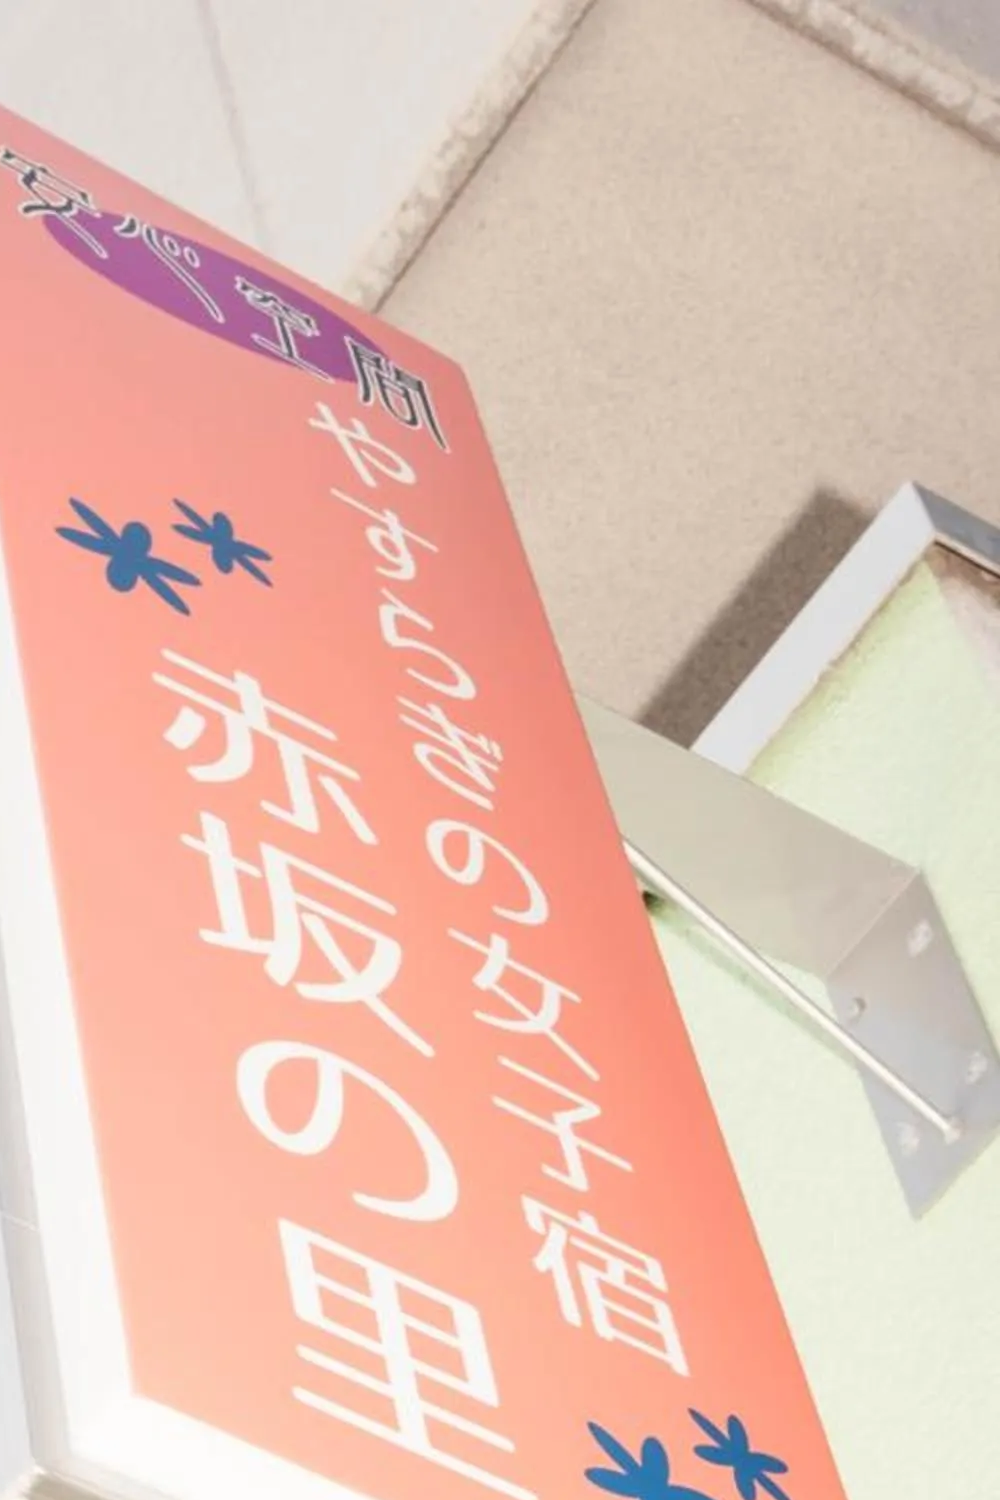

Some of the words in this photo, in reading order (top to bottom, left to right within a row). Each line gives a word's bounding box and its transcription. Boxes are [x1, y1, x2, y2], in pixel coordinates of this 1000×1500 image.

[309, 402, 690, 1377] やすらぎの女子宿
